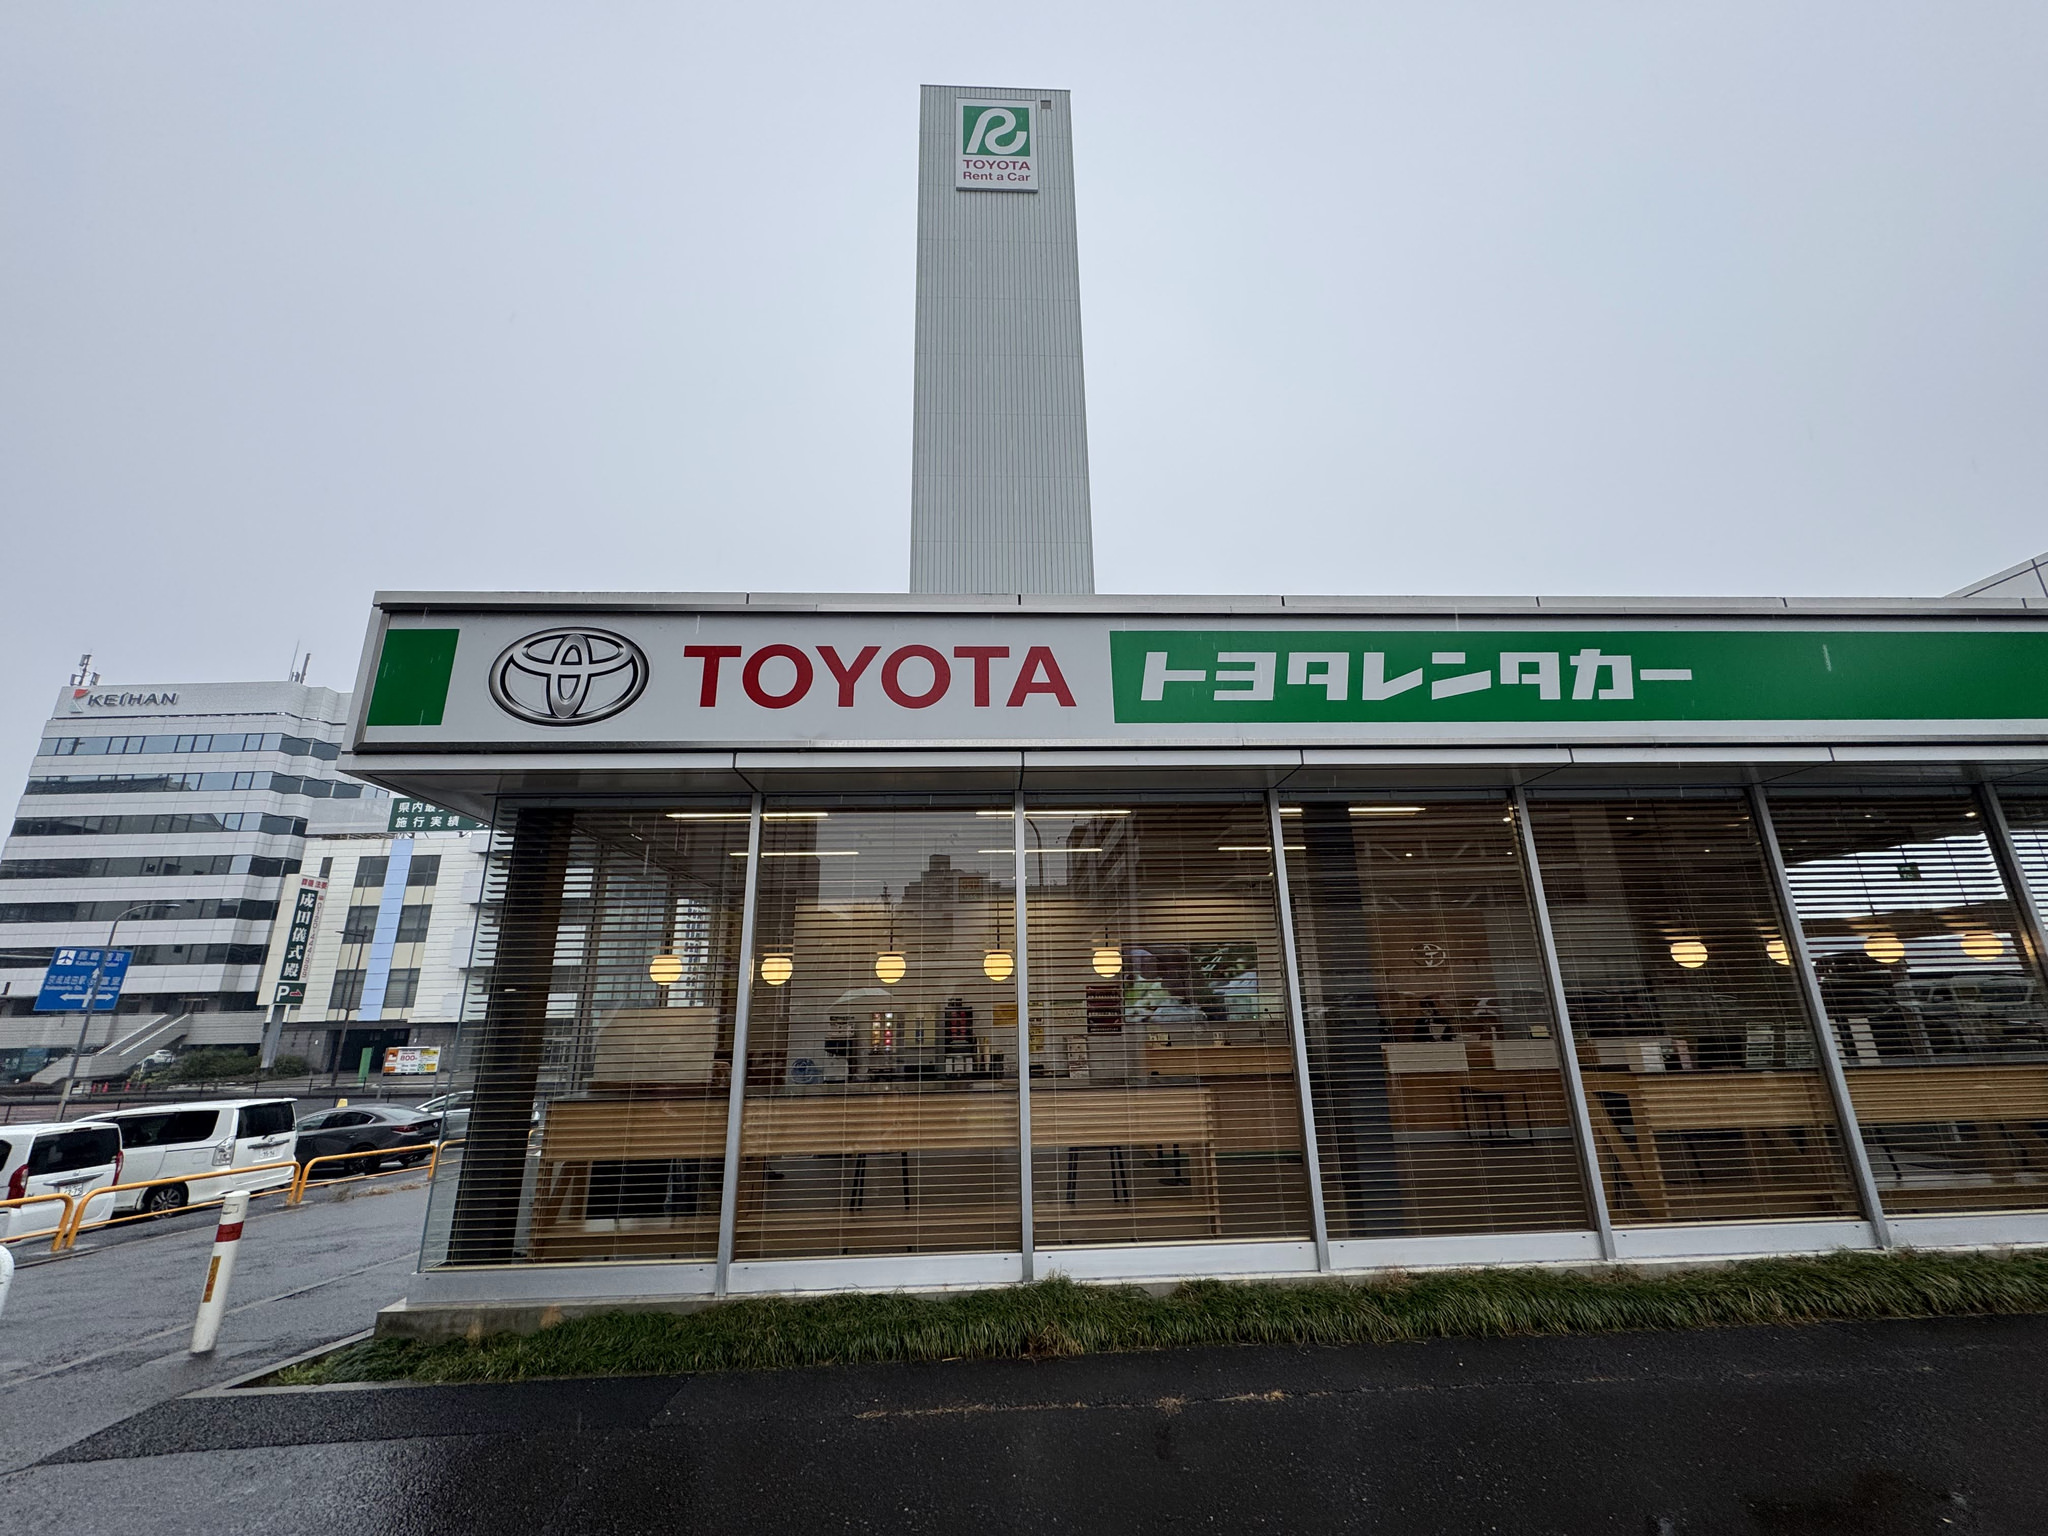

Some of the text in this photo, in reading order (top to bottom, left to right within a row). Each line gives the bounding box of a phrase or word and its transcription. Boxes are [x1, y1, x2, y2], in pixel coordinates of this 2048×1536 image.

[963, 160, 1030, 170] TOYOTA
[963, 171, 993, 180] Rent
[1007, 172, 1030, 181] Car
[684, 643, 1077, 709] TOYOTA
[1141, 649, 1692, 701] トヨタレンタカー
[88, 692, 177, 706] KEIHAN
[398, 802, 445, 813] 県内最
[283, 893, 315, 977] 成田儀式殿
[275, 985, 290, 1002] P
